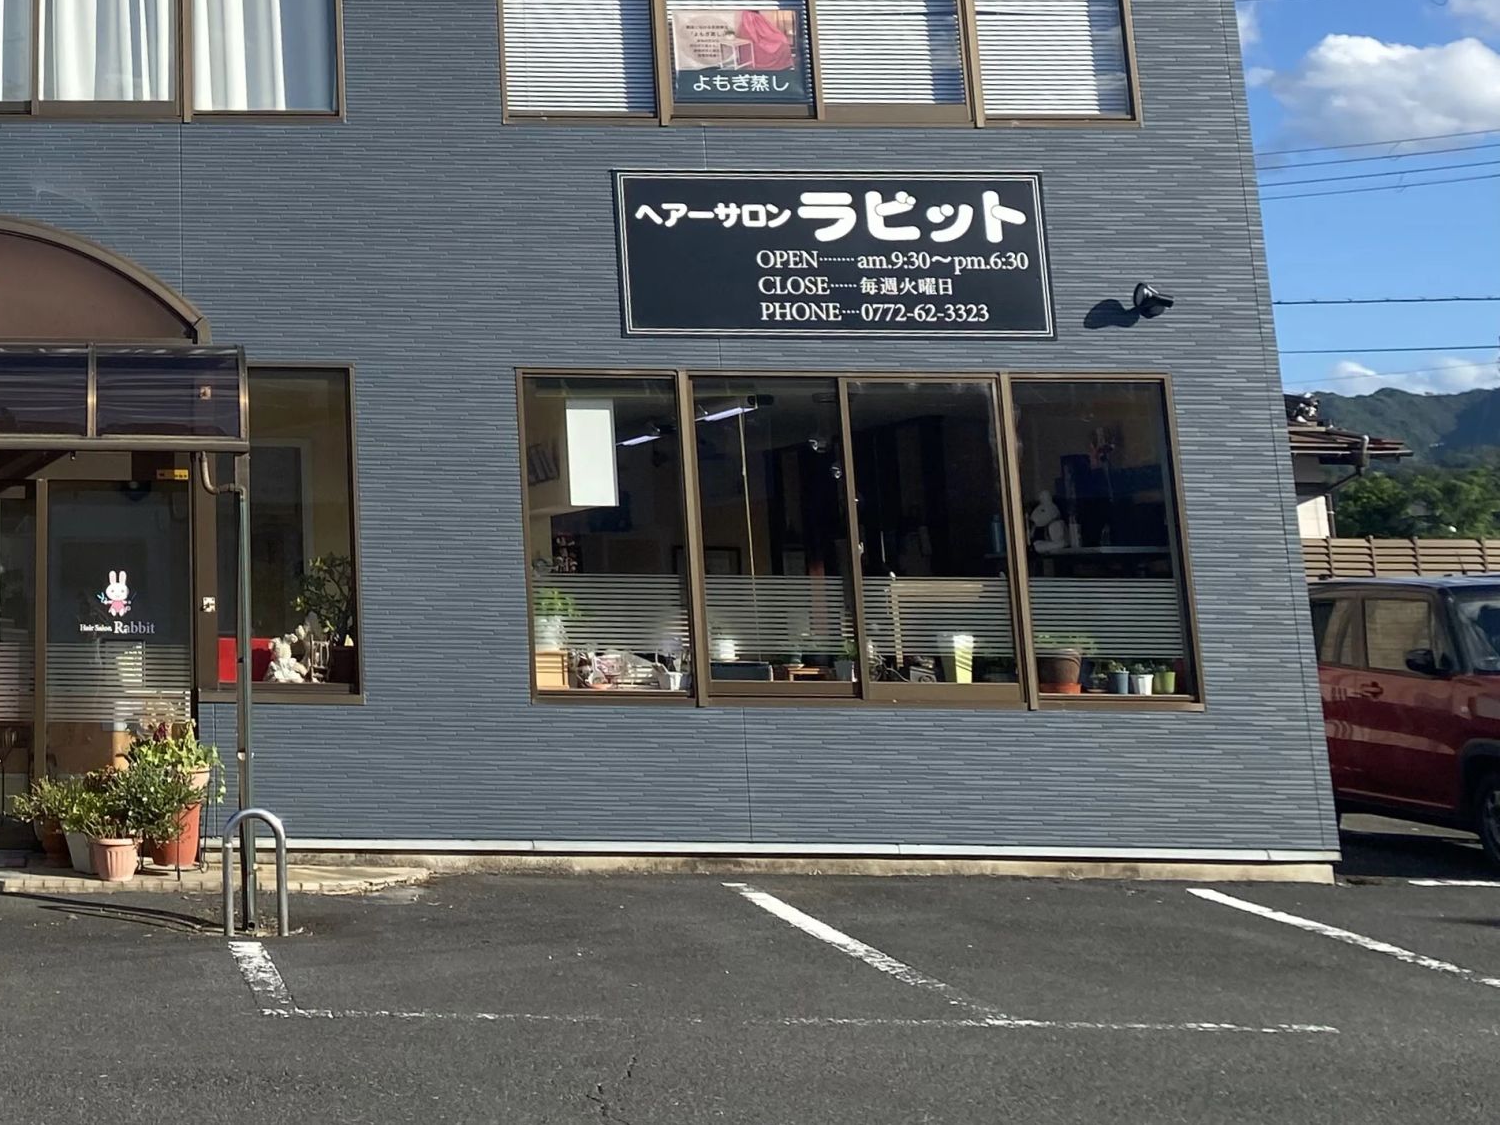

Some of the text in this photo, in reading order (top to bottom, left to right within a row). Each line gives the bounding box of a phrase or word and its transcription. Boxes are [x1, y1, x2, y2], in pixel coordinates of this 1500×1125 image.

[693, 74, 790, 92] よもぎ蒸し
[634, 190, 1027, 244] ヘアーサロン ラビット
[756, 249, 819, 269] OPEN
[758, 276, 954, 296] CLOSE 毎週火曜日
[760, 302, 990, 322] PHONE 0772-62-3323
[113, 620, 155, 634] Rabbit
